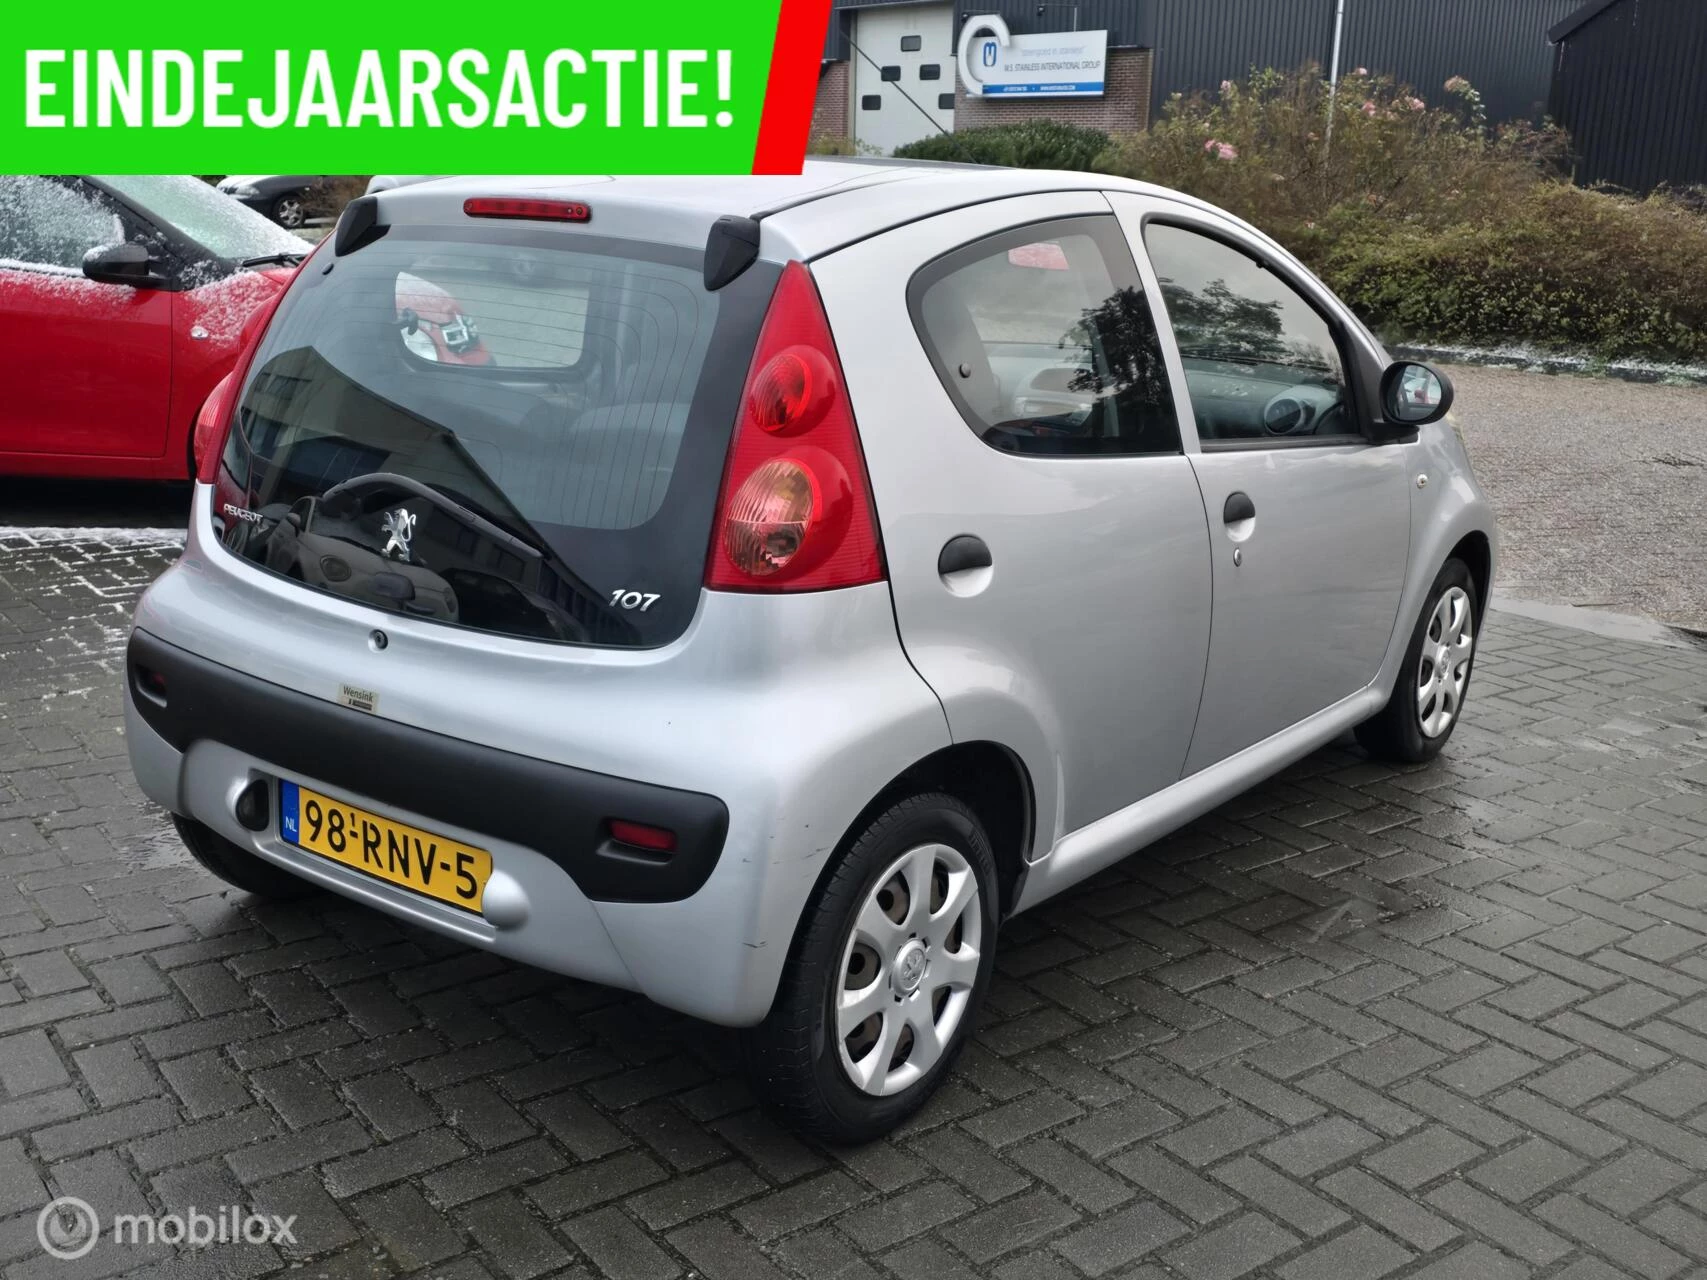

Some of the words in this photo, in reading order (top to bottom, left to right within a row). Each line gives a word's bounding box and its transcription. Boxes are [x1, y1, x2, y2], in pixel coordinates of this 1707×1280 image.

[1041, 61, 1080, 71] INTERNATIONAL
[223, 503, 263, 525] PEUGEOT
[608, 589, 661, 612] 107
[343, 684, 373, 703] Wensink
[285, 815, 297, 833] NL
[305, 799, 478, 900] 98-RNV-5
